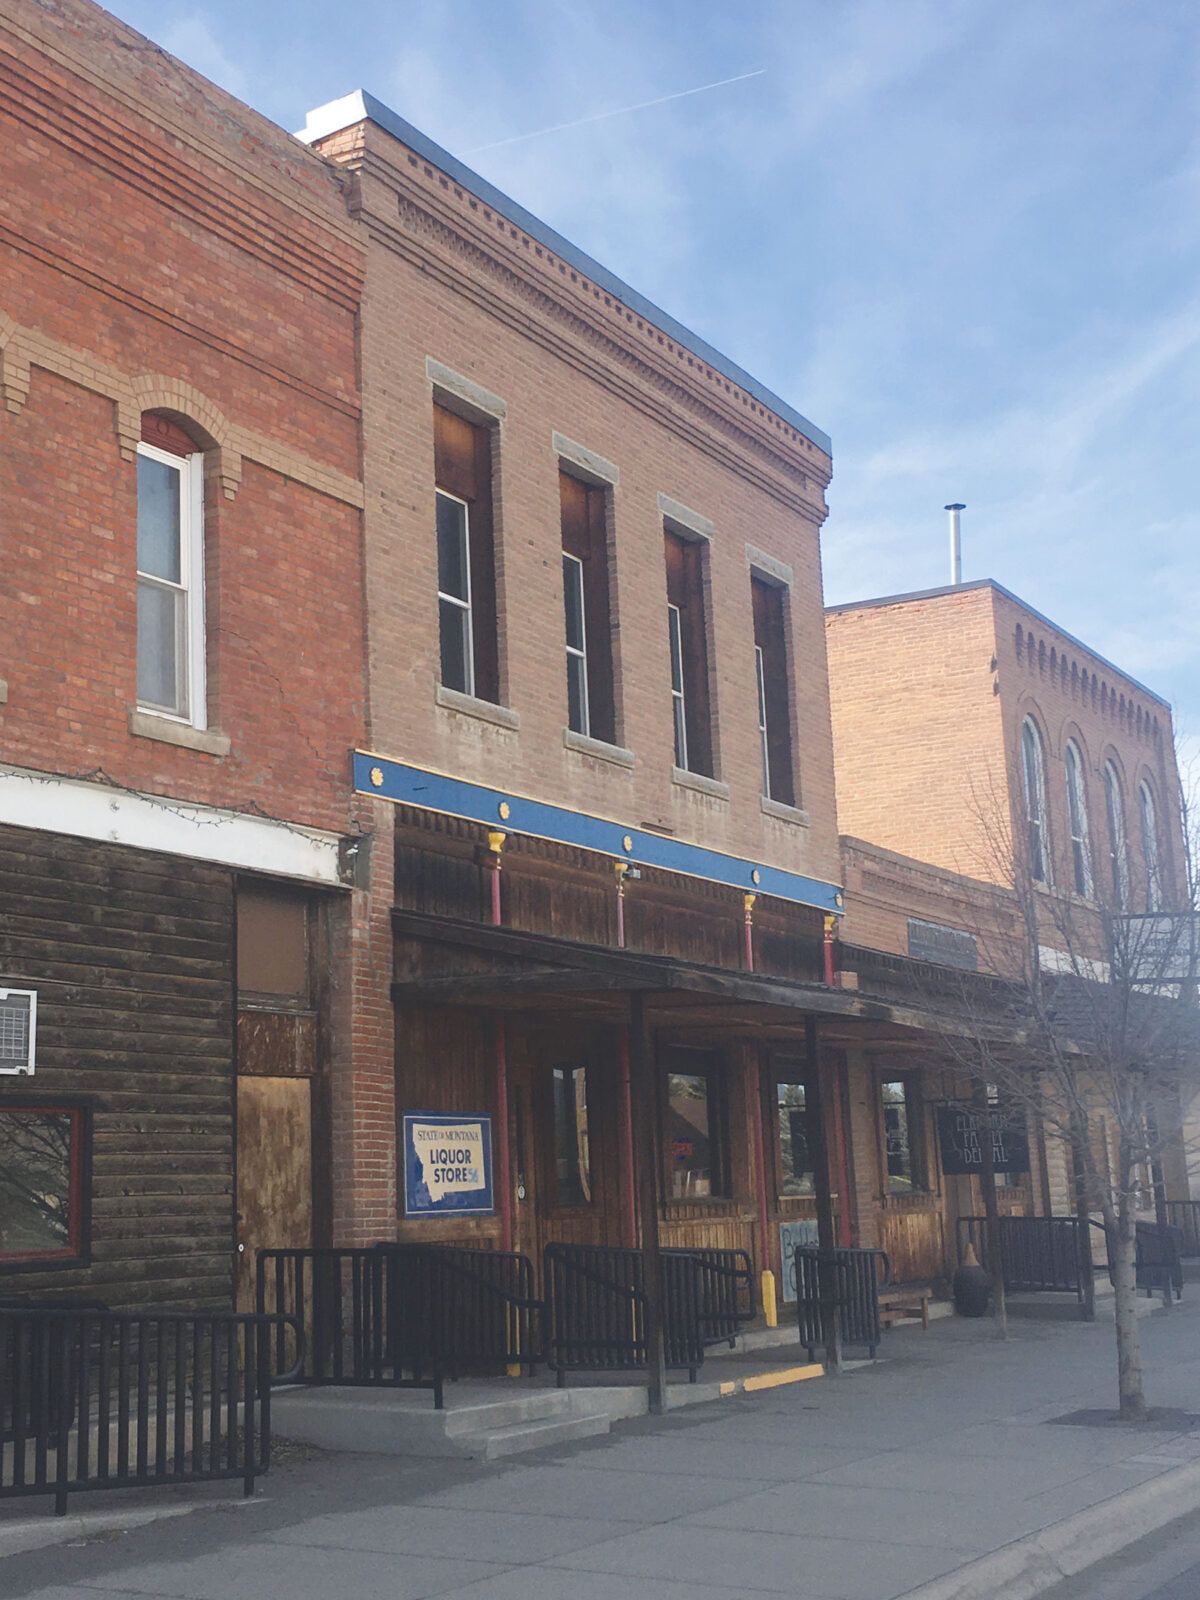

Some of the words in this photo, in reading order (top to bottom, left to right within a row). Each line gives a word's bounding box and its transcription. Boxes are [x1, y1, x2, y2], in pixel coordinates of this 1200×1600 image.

[418, 1130, 437, 1141] STATE
[445, 1130, 479, 1142] MONTANA
[430, 1149, 471, 1165] LIQUOR
[434, 1168, 468, 1183] STORE
